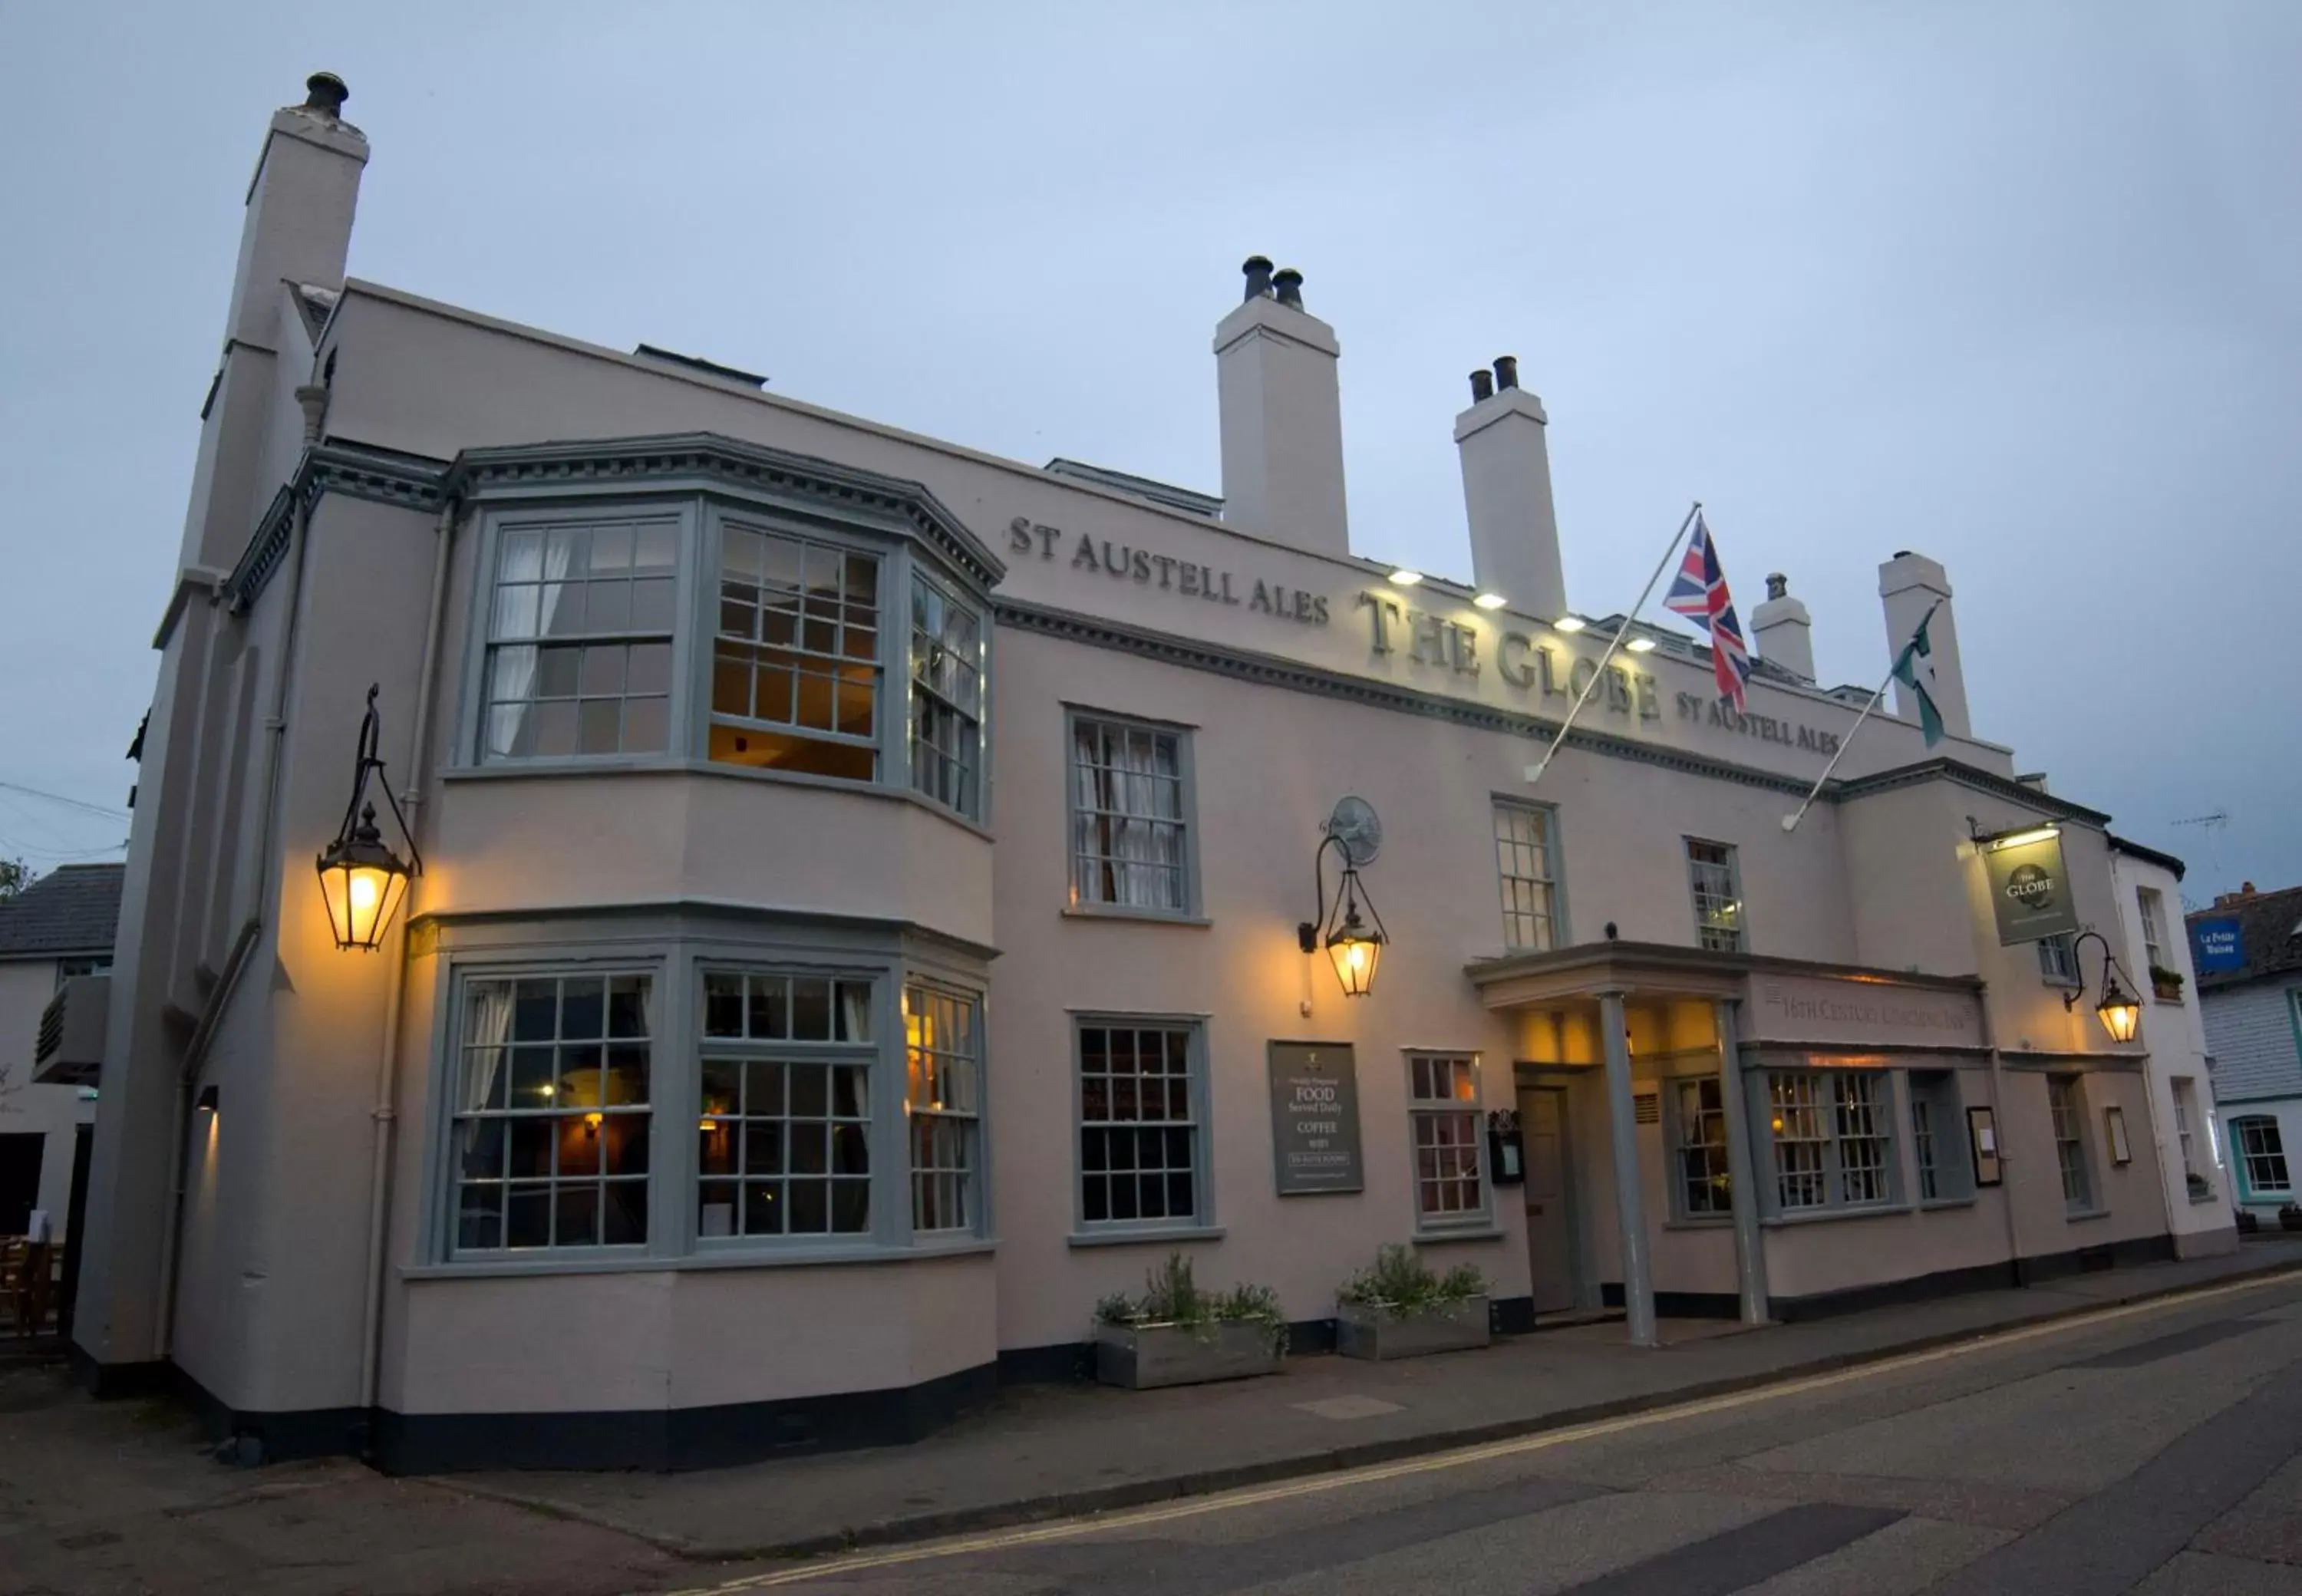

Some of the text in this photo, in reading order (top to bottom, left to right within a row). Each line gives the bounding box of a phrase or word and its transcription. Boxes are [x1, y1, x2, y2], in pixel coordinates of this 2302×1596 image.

[1009, 516, 1330, 625] ST AUSTELL ALES
[1357, 589, 1661, 721] THE GLOBE
[1676, 691, 1703, 722] ST
[1797, 724, 1839, 755] ALES
[2006, 878, 2054, 897] GLOBE
[1296, 1087, 1335, 1101] FOOD
[1297, 1121, 1338, 1133] COFFEE
